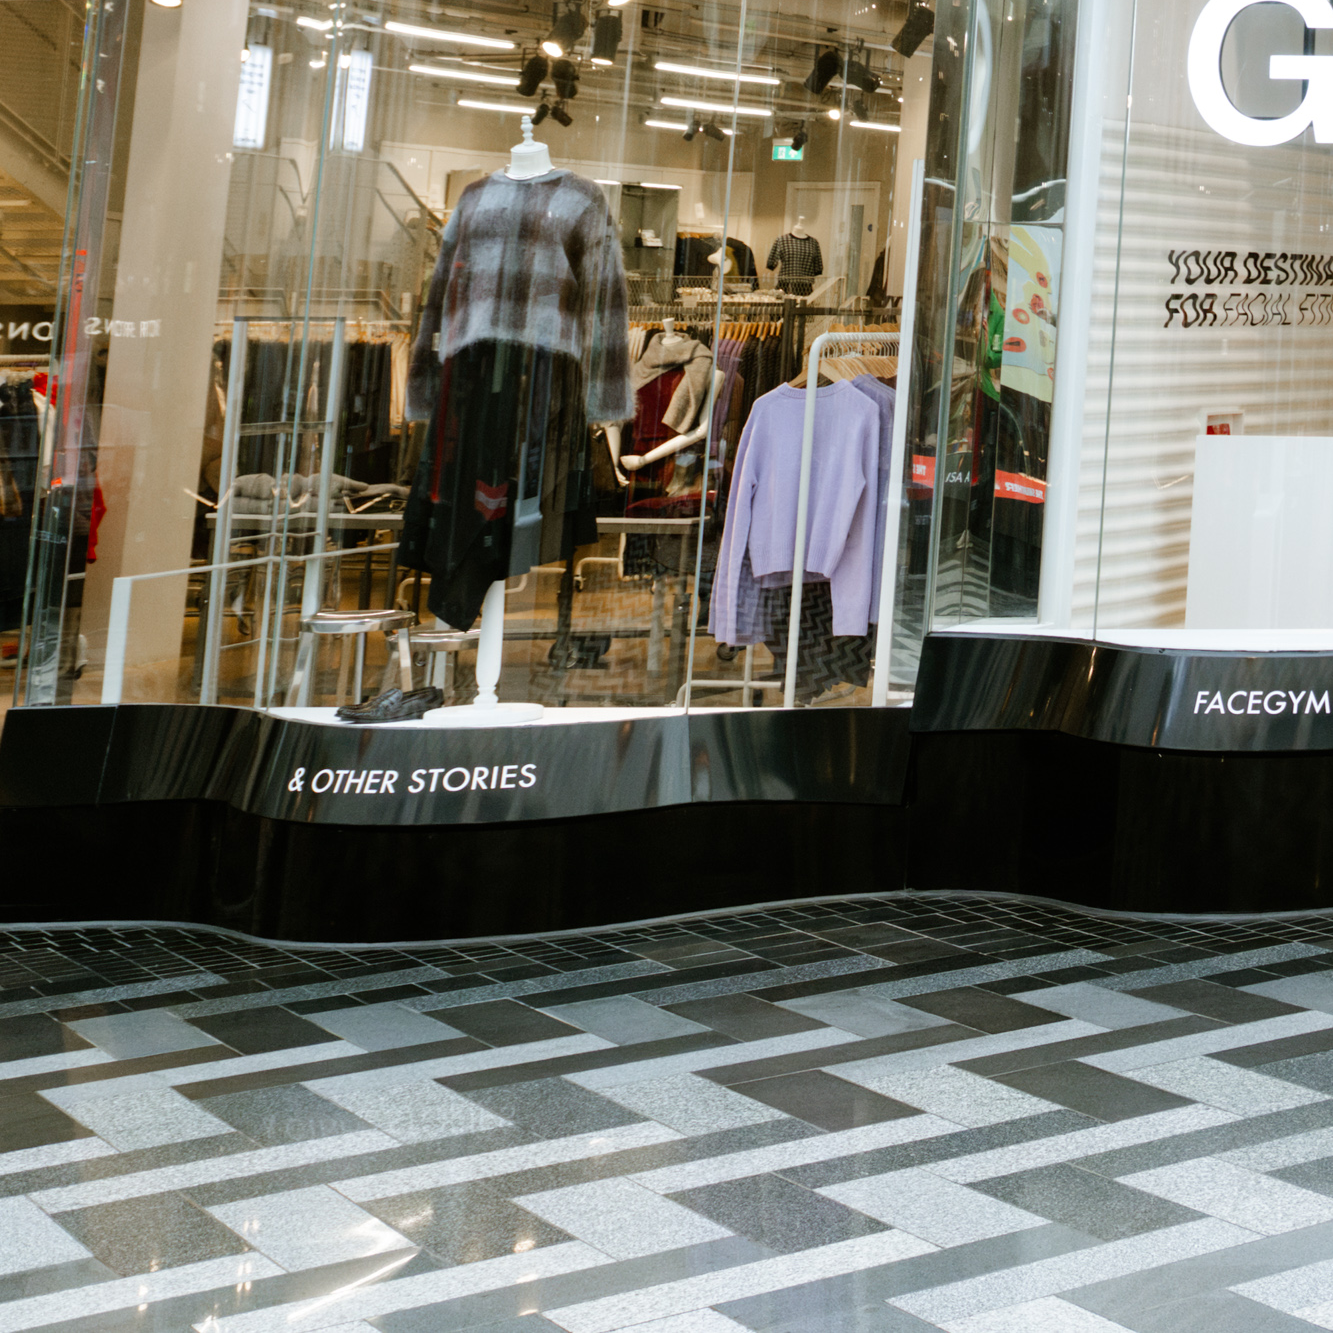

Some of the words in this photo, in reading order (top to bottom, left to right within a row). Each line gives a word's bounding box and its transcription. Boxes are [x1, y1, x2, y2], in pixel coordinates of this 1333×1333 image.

[1167, 250, 1238, 286] YOUR
[1163, 293, 1218, 329] FOR
[1220, 292, 1291, 326] FACIAL
[1193, 689, 1331, 715] FACEGYM
[287, 765, 306, 794] &
[310, 767, 399, 796] OTHER
[407, 763, 538, 794] STORIES
